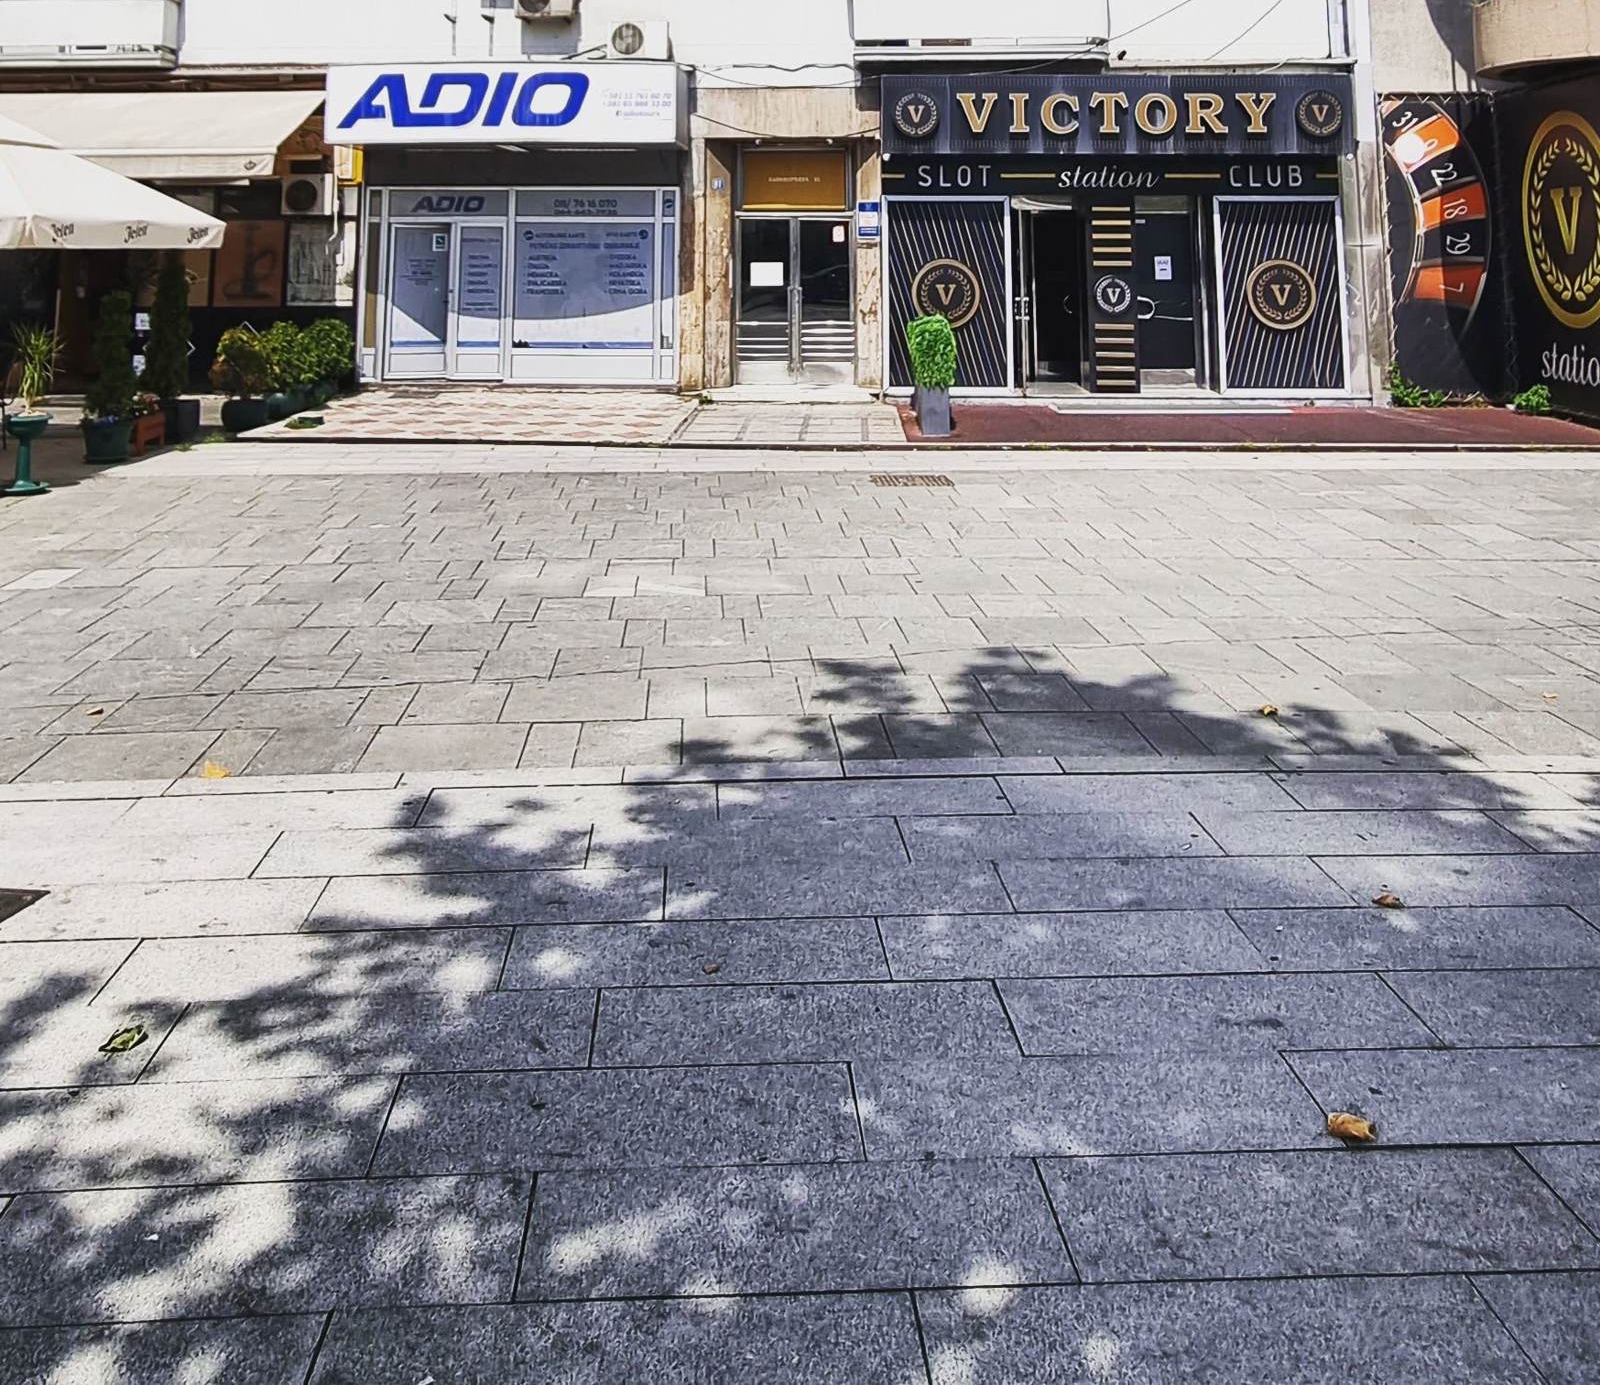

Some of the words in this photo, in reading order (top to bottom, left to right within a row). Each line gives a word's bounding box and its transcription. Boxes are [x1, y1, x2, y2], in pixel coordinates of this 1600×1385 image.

[336, 71, 591, 129] ADIO
[907, 105, 925, 124] V
[956, 92, 1277, 135] VICTORY
[1311, 104, 1329, 123] V
[1392, 111, 1420, 134] 31
[917, 165, 992, 188] SLOT
[1057, 164, 1161, 189] station
[1228, 165, 1304, 188] CLUB
[1430, 162, 1458, 188] 22
[410, 195, 486, 214] ADIO
[598, 198, 619, 209] 070
[1442, 198, 1469, 220] 18
[1550, 185, 1583, 256] V
[1445, 232, 1472, 255] 29
[935, 283, 957, 306] V
[1106, 287, 1121, 304] V
[1270, 283, 1292, 307] V
[1439, 282, 1465, 294] 7
[1541, 341, 1600, 388] statio
